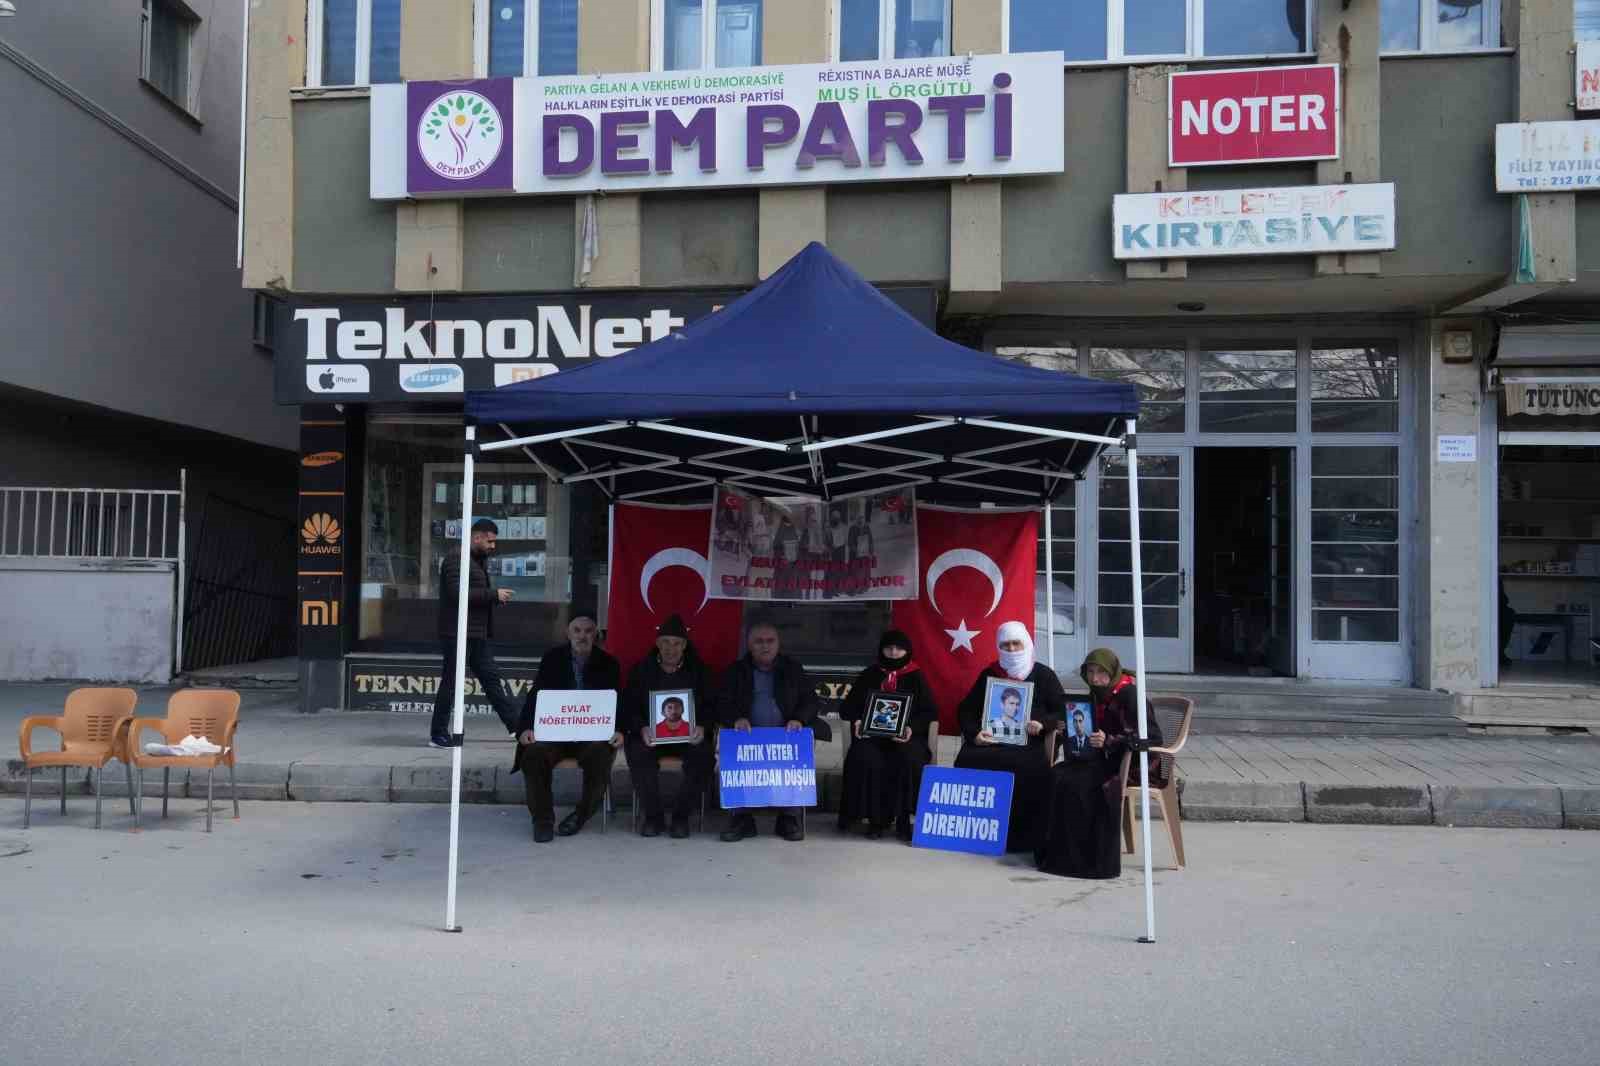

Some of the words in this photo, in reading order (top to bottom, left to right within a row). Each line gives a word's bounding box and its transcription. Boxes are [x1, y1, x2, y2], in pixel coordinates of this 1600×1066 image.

[590, 81, 627, 94] GELAN
[631, 81, 639, 92] A
[818, 86, 859, 103] MUŞ
[866, 82, 882, 99] İL
[889, 79, 972, 98] ÖRGÜTÜ
[545, 99, 608, 111] HALKLARIN
[610, 95, 651, 109] EŞİTLİK
[655, 96, 669, 107] VE
[671, 93, 735, 106] DEMOKRASİ
[740, 88, 784, 103] PARTİSİ
[543, 107, 717, 178] DEM
[747, 71, 1012, 171] PARTİ
[1181, 94, 1327, 136] NOTER
[436, 161, 455, 175] DEM
[1508, 158, 1543, 174] FİLİZ
[1122, 212, 1385, 249] KIRTASİYE
[294, 305, 685, 360] TeknoNet
[301, 546, 341, 554] HUAWEI
[539, 714, 612, 725] NÖBETİNDEYİZ
[561, 704, 592, 713] EVLAT
[737, 744, 764, 761] ARTIK
[766, 744, 793, 760] YETER
[721, 768, 782, 787] YAKAMIZDAN
[784, 764, 816, 790] DÜŞÜN
[929, 782, 996, 809] ANNELER
[922, 808, 999, 841] DİRENİYOR
